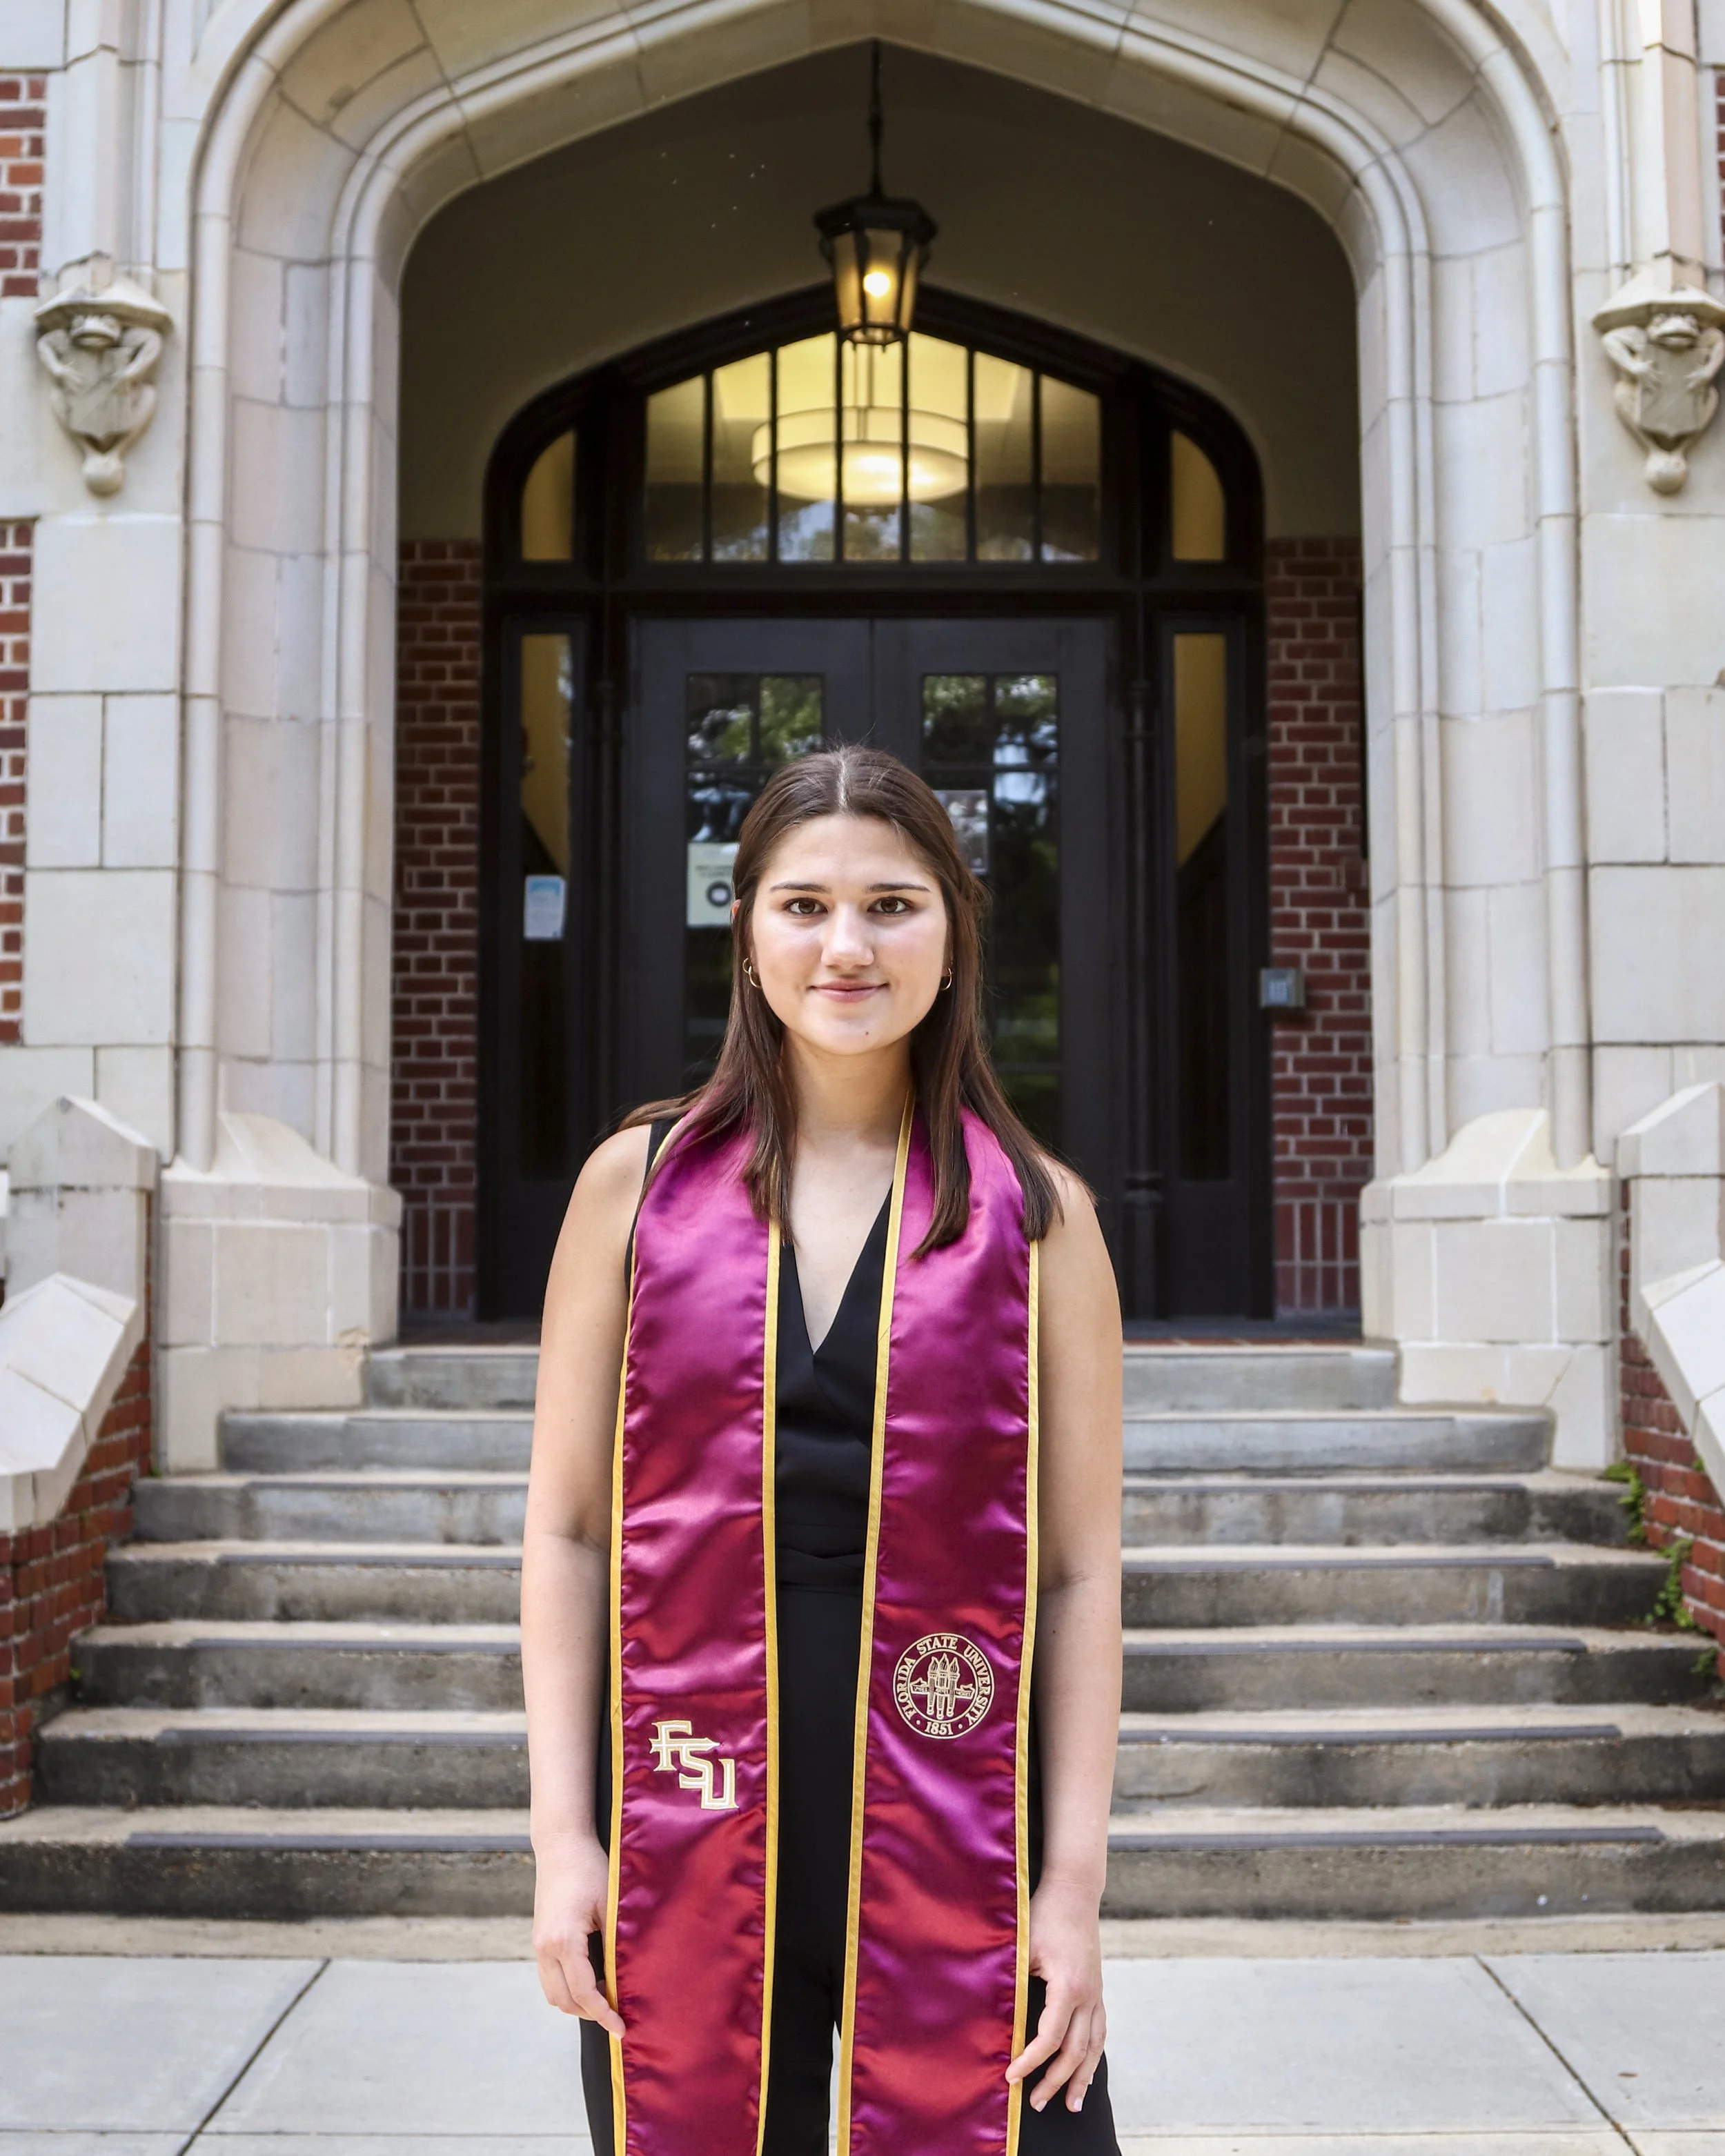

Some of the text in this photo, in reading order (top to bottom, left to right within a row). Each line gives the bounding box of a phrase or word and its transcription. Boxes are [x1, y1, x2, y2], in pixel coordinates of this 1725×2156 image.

[897, 1636, 990, 1725] FLORIDA STATE UNIVERSITY
[649, 1720, 739, 1809] FSU
[925, 1721, 954, 1735] 1851
